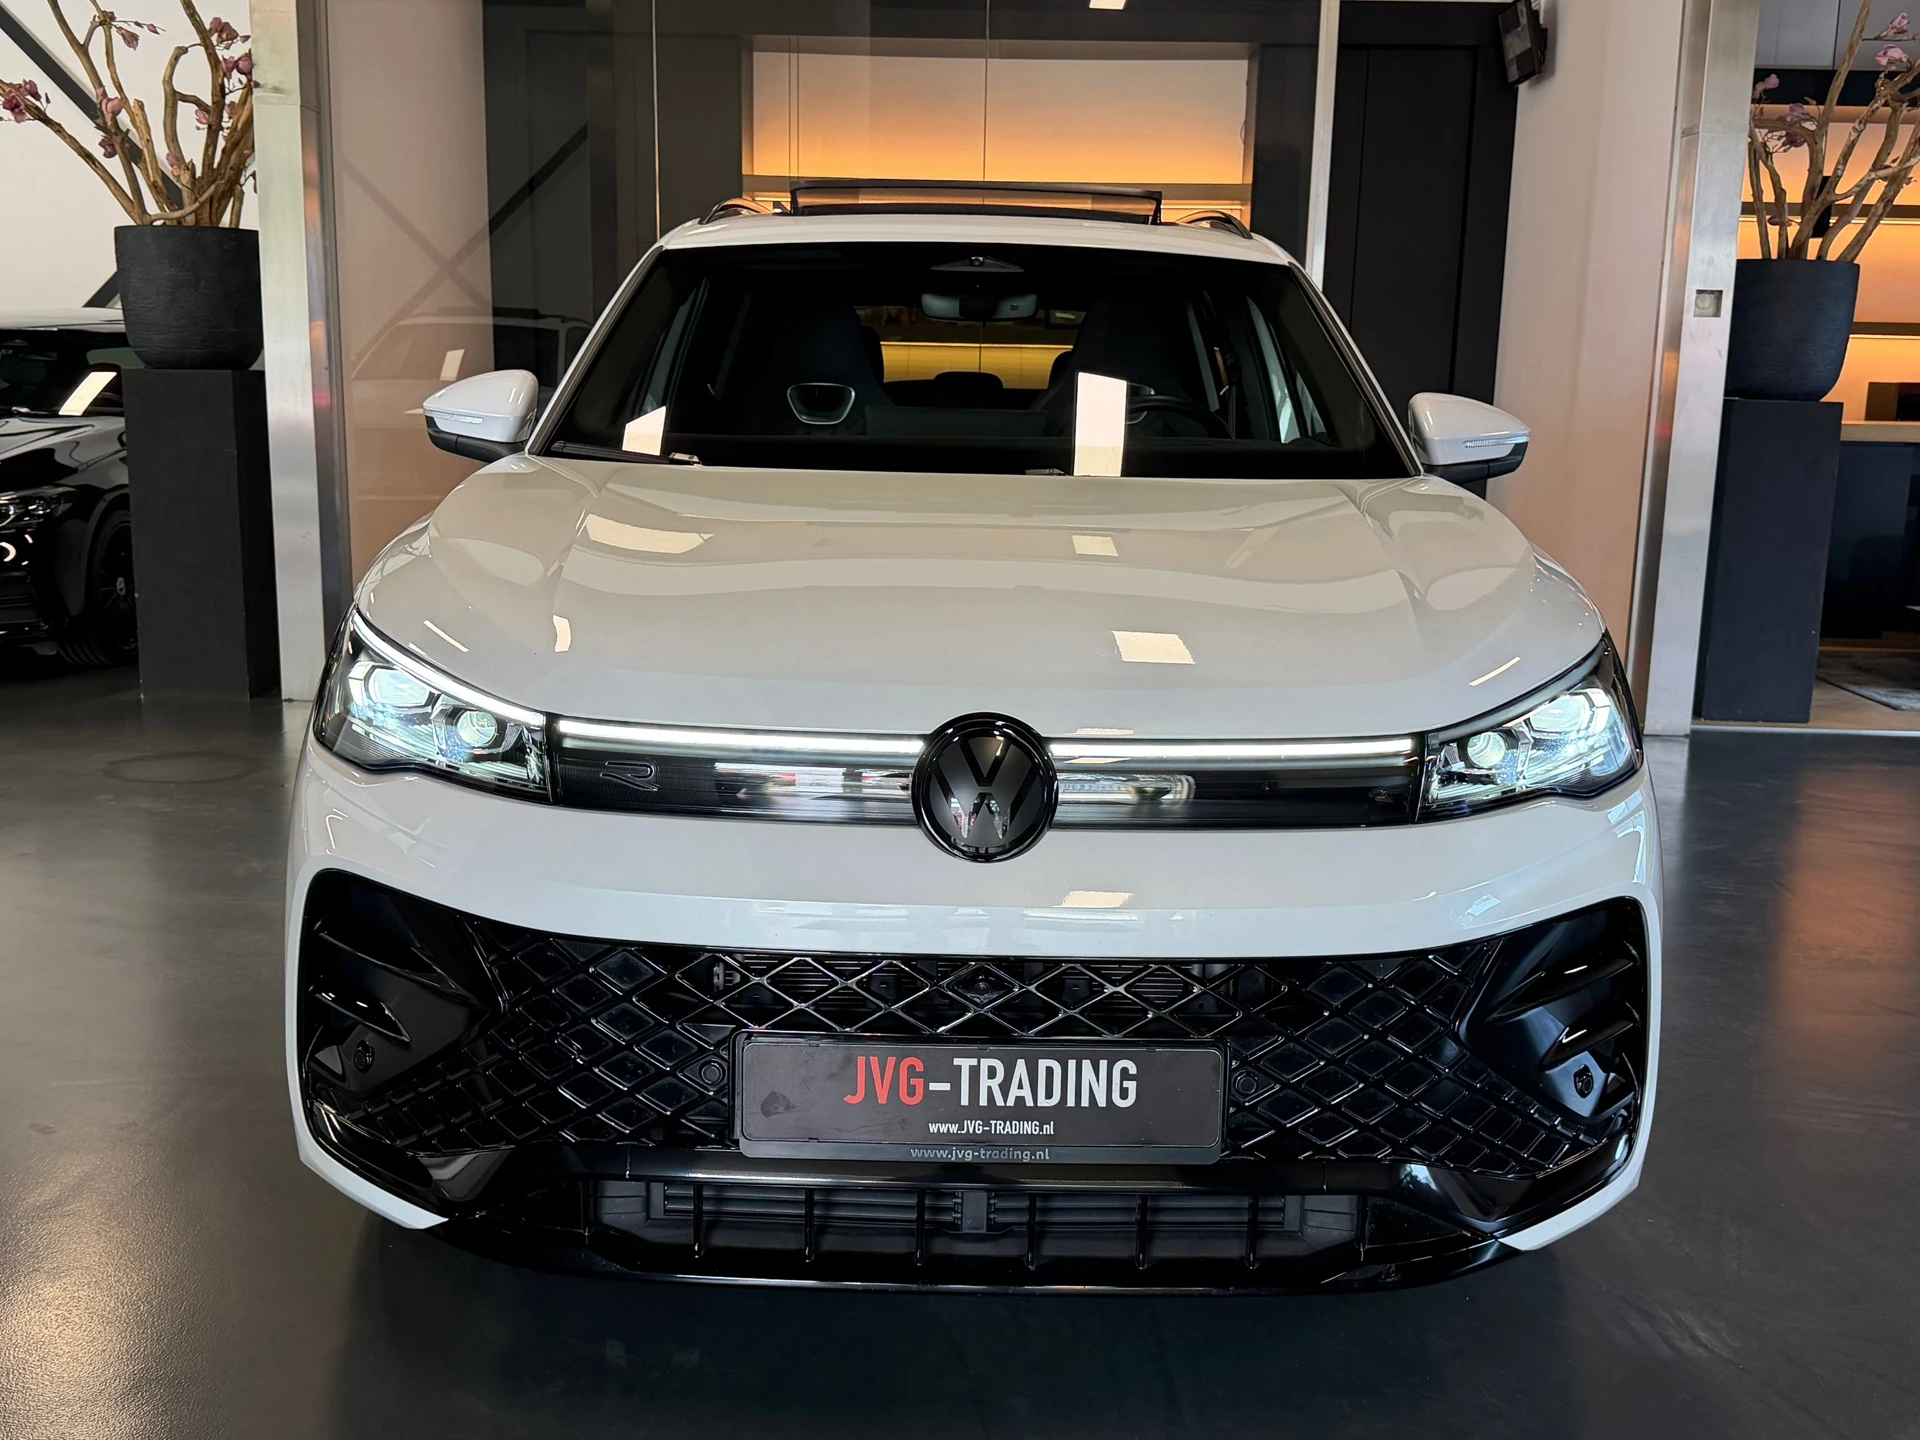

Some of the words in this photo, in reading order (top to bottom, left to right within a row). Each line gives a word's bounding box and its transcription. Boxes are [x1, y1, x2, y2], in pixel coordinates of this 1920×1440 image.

[843, 1056, 1138, 1108] JVG-TRADING
[928, 1120, 1054, 1136] www.JVG-TRADING.nl
[910, 1146, 1050, 1162] www.jvg-trading.nl
